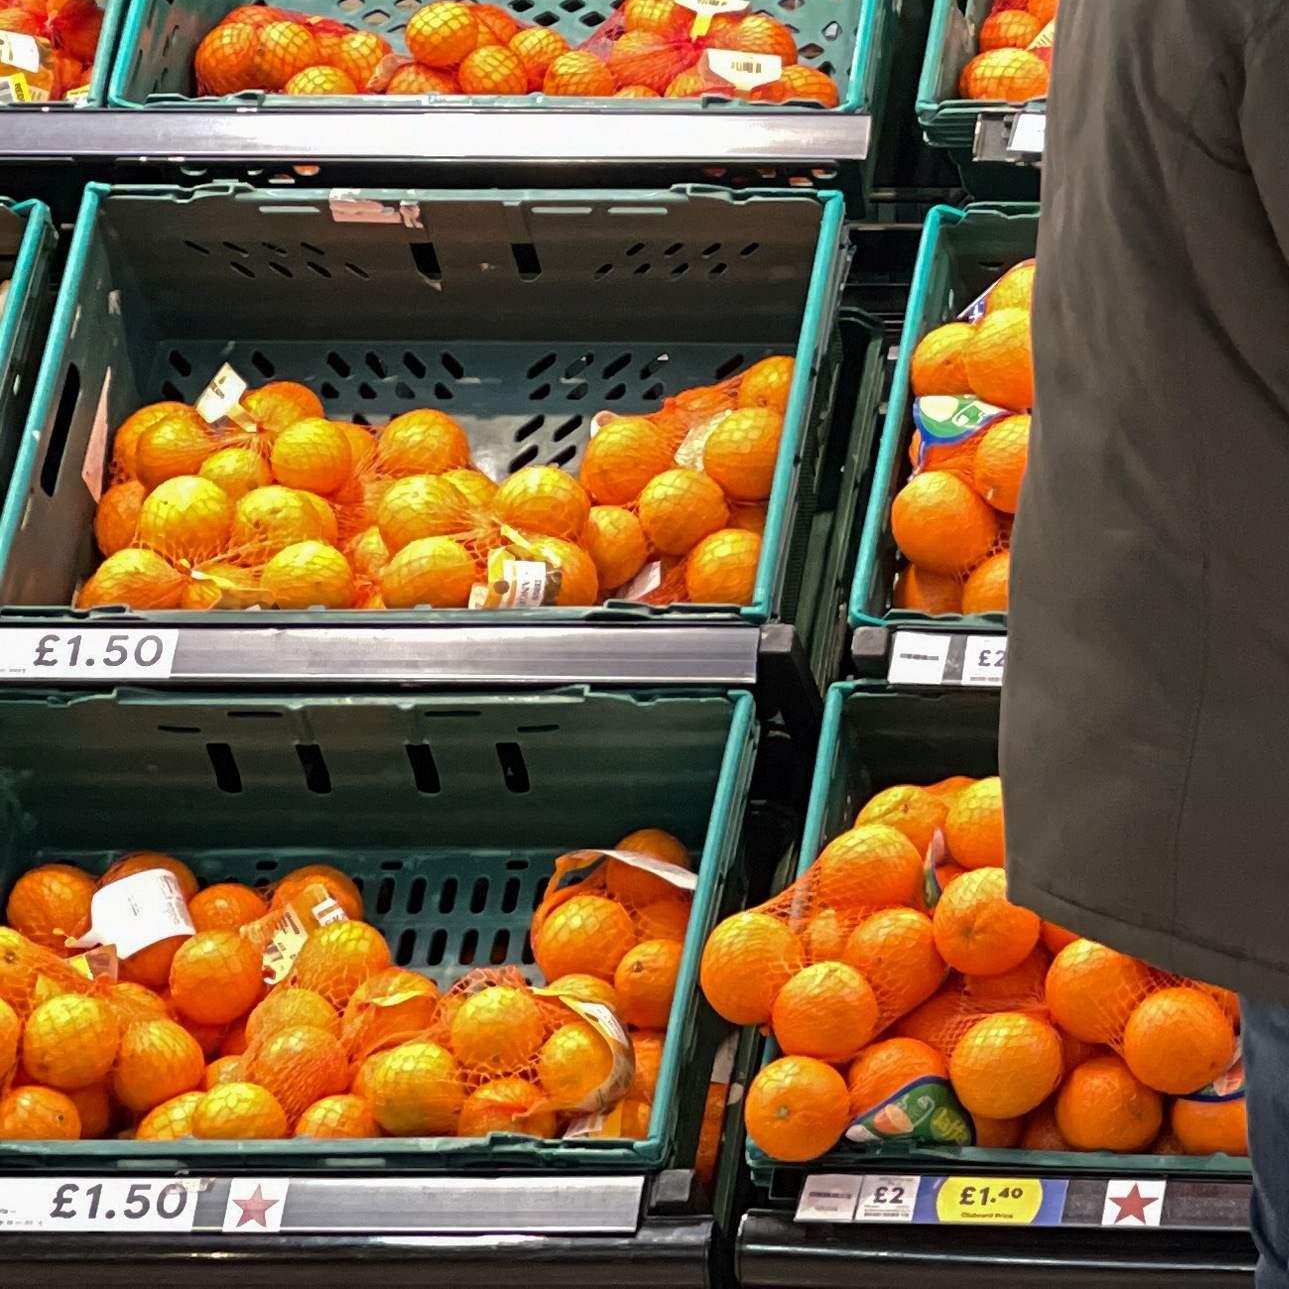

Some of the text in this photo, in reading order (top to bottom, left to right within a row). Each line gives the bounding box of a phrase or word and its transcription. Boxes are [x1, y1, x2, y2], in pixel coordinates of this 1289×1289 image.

[33, 634, 164, 667] £1.50
[49, 1183, 188, 1220] £1.50
[873, 1186, 905, 1204] £2
[959, 1186, 1023, 1206] £1.40
